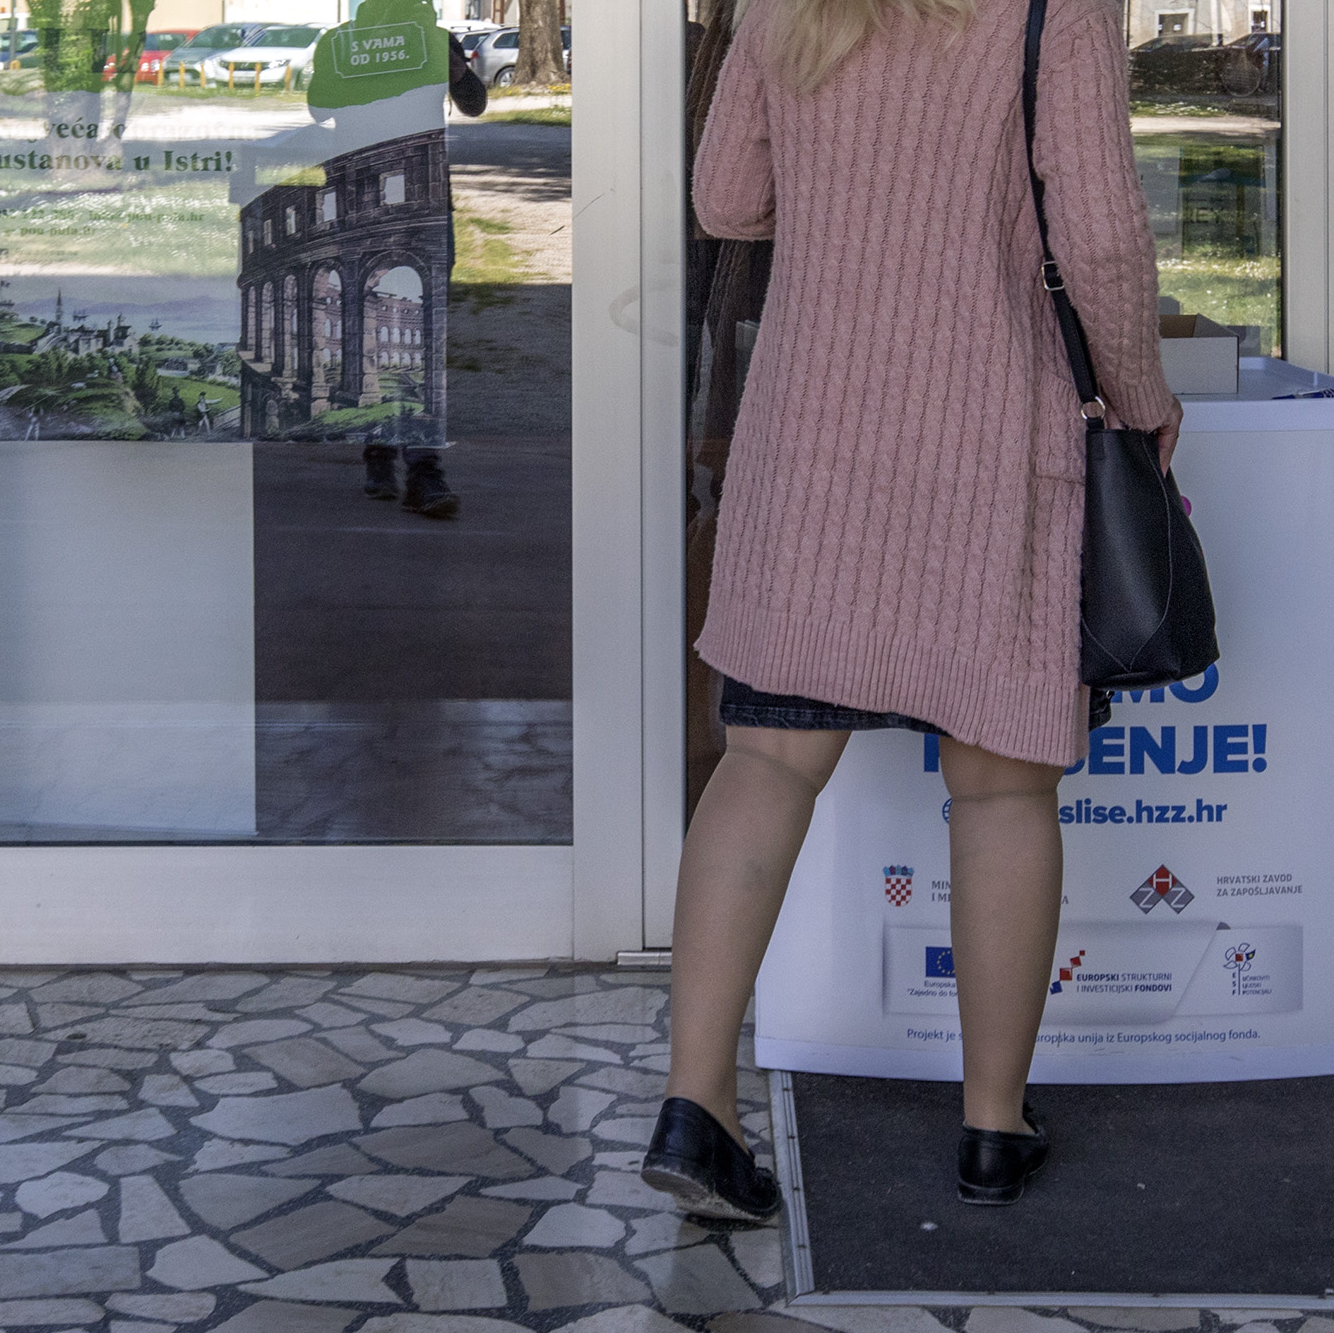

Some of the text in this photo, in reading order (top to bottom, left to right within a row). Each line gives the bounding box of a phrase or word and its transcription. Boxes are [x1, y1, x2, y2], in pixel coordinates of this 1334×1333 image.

[351, 35, 405, 52] S VAMA
[350, 50, 410, 66] OD 1956.
[134, 155, 150, 171] u
[164, 150, 233, 172] Istri!
[1217, 874, 1292, 885] HRVATSKI ZAVOD
[1217, 885, 1303, 897] ZA ZAPOŠLJAVANJE
[1077, 973, 1172, 982] EUROPSKI STRUKTURNI
[924, 981, 956, 990] Europska
[1081, 985, 1133, 994] INVESTICIJSKI
[1135, 984, 1172, 992] FONDOVI
[907, 1028, 956, 1041] Projekt je
[1034, 1029, 1261, 1044] uropska unija iz Europskog socijalnog fonda.
